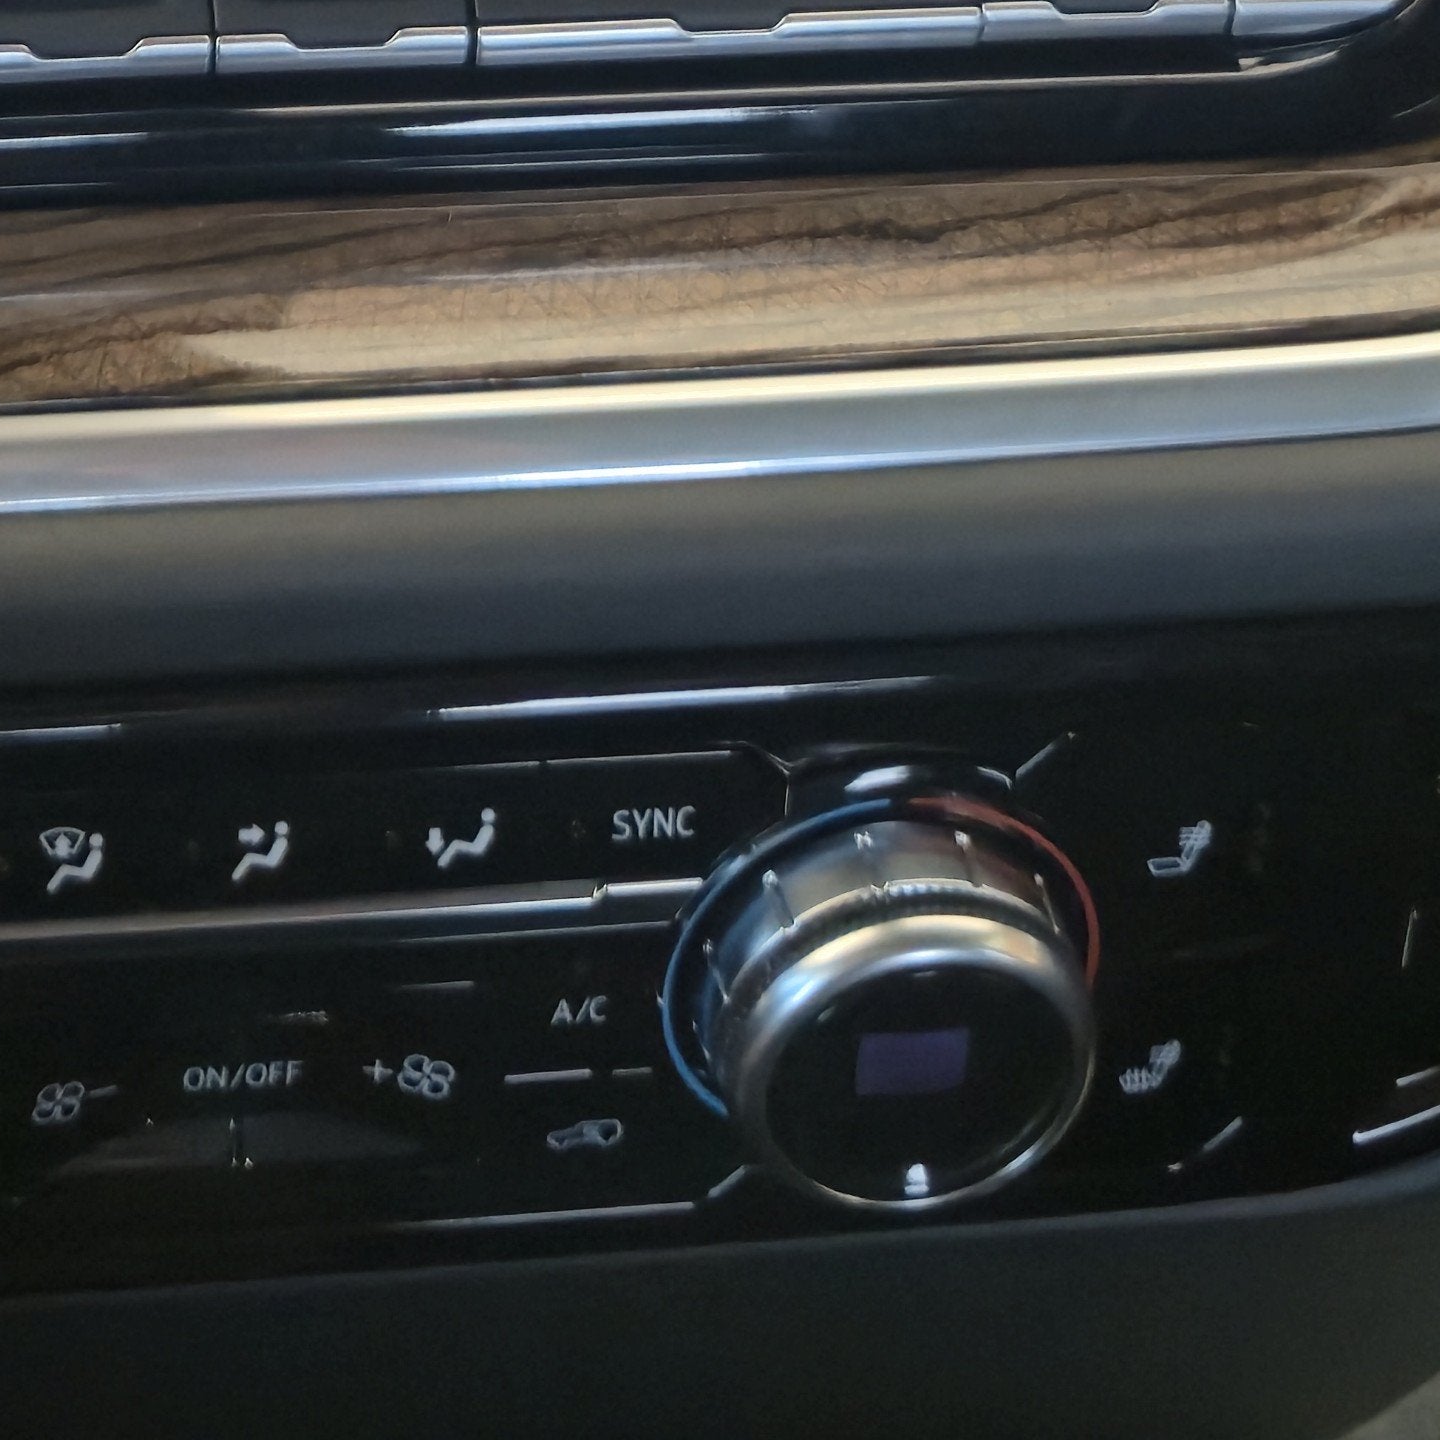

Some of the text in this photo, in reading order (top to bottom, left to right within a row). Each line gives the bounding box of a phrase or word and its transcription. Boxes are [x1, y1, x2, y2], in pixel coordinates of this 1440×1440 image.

[611, 805, 696, 841] SYNC
[550, 995, 607, 1024] A/C
[182, 1060, 303, 1092] ON/OFF
